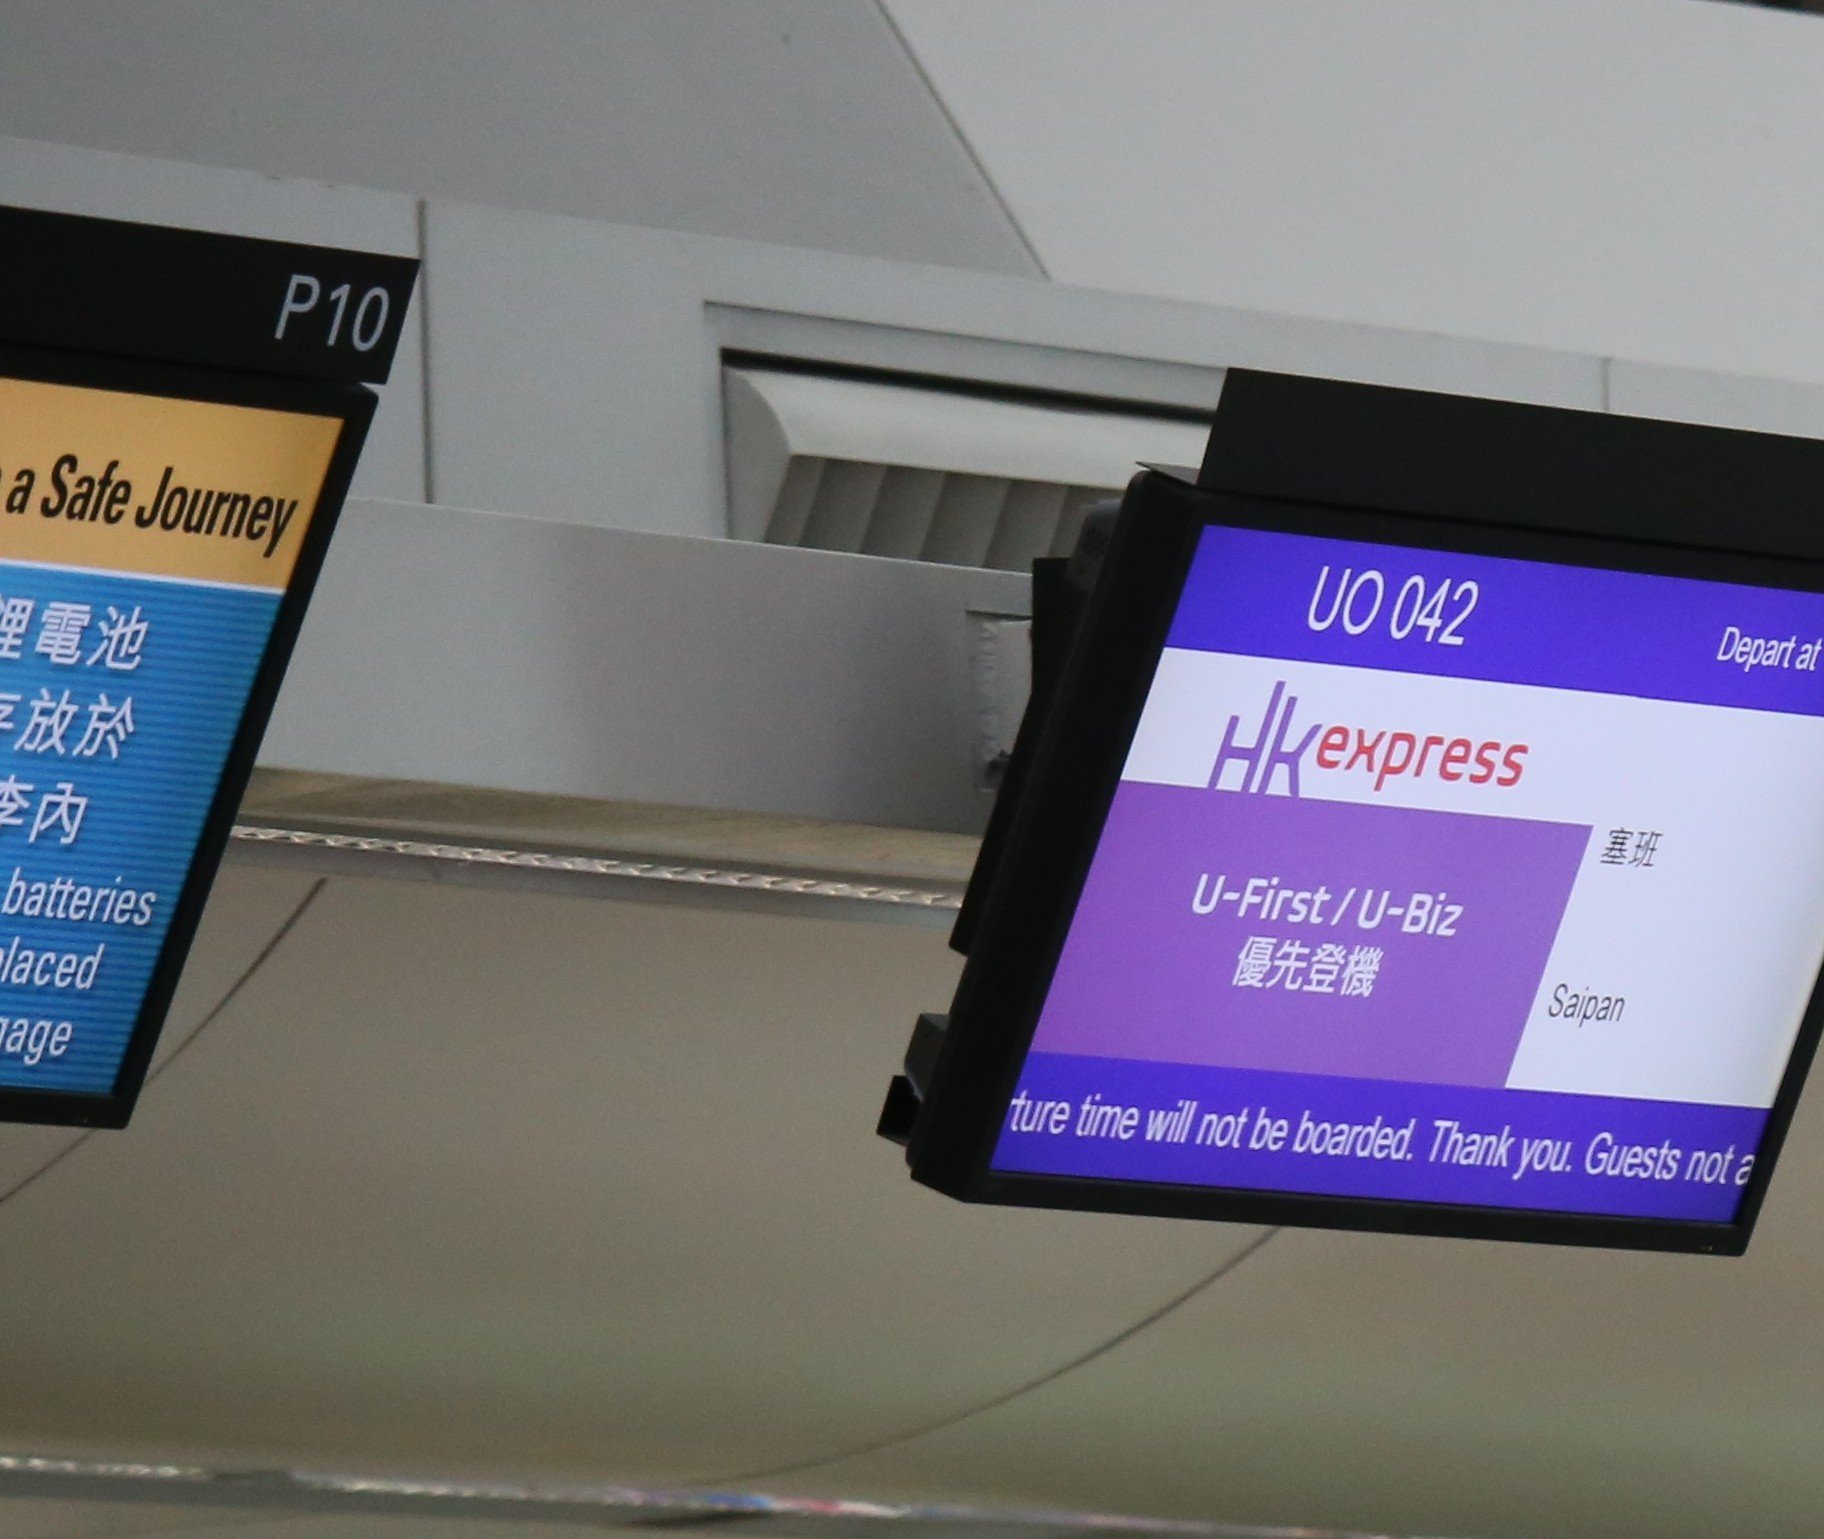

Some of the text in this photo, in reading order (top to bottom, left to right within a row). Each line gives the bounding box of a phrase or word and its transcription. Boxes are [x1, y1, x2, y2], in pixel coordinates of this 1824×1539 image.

[275, 274, 390, 351] P10
[5, 454, 298, 558] a Safe Journey
[1307, 565, 1479, 645] UO 042
[1716, 626, 1797, 672] Depart
[1795, 637, 1823, 671] at
[1600, 827, 1664, 868] 塞班
[2, 866, 157, 926] batteries
[1192, 873, 1464, 937] U-First / U-Biz
[0, 936, 105, 990] laced
[1232, 935, 1384, 998] 優先登機
[1548, 983, 1626, 1028] Saipan
[1010, 1089, 1071, 1135] ture
[1075, 1092, 1140, 1140] time
[1145, 1099, 1198, 1144] will
[1196, 1106, 1249, 1149] not
[1248, 1106, 1289, 1151] be
[1293, 1109, 1417, 1162] boarded.
[1428, 1119, 1516, 1169] Thank
[1512, 1138, 1573, 1180] you.
[1584, 1131, 1682, 1181] Guests
[1684, 1144, 1736, 1184] not
